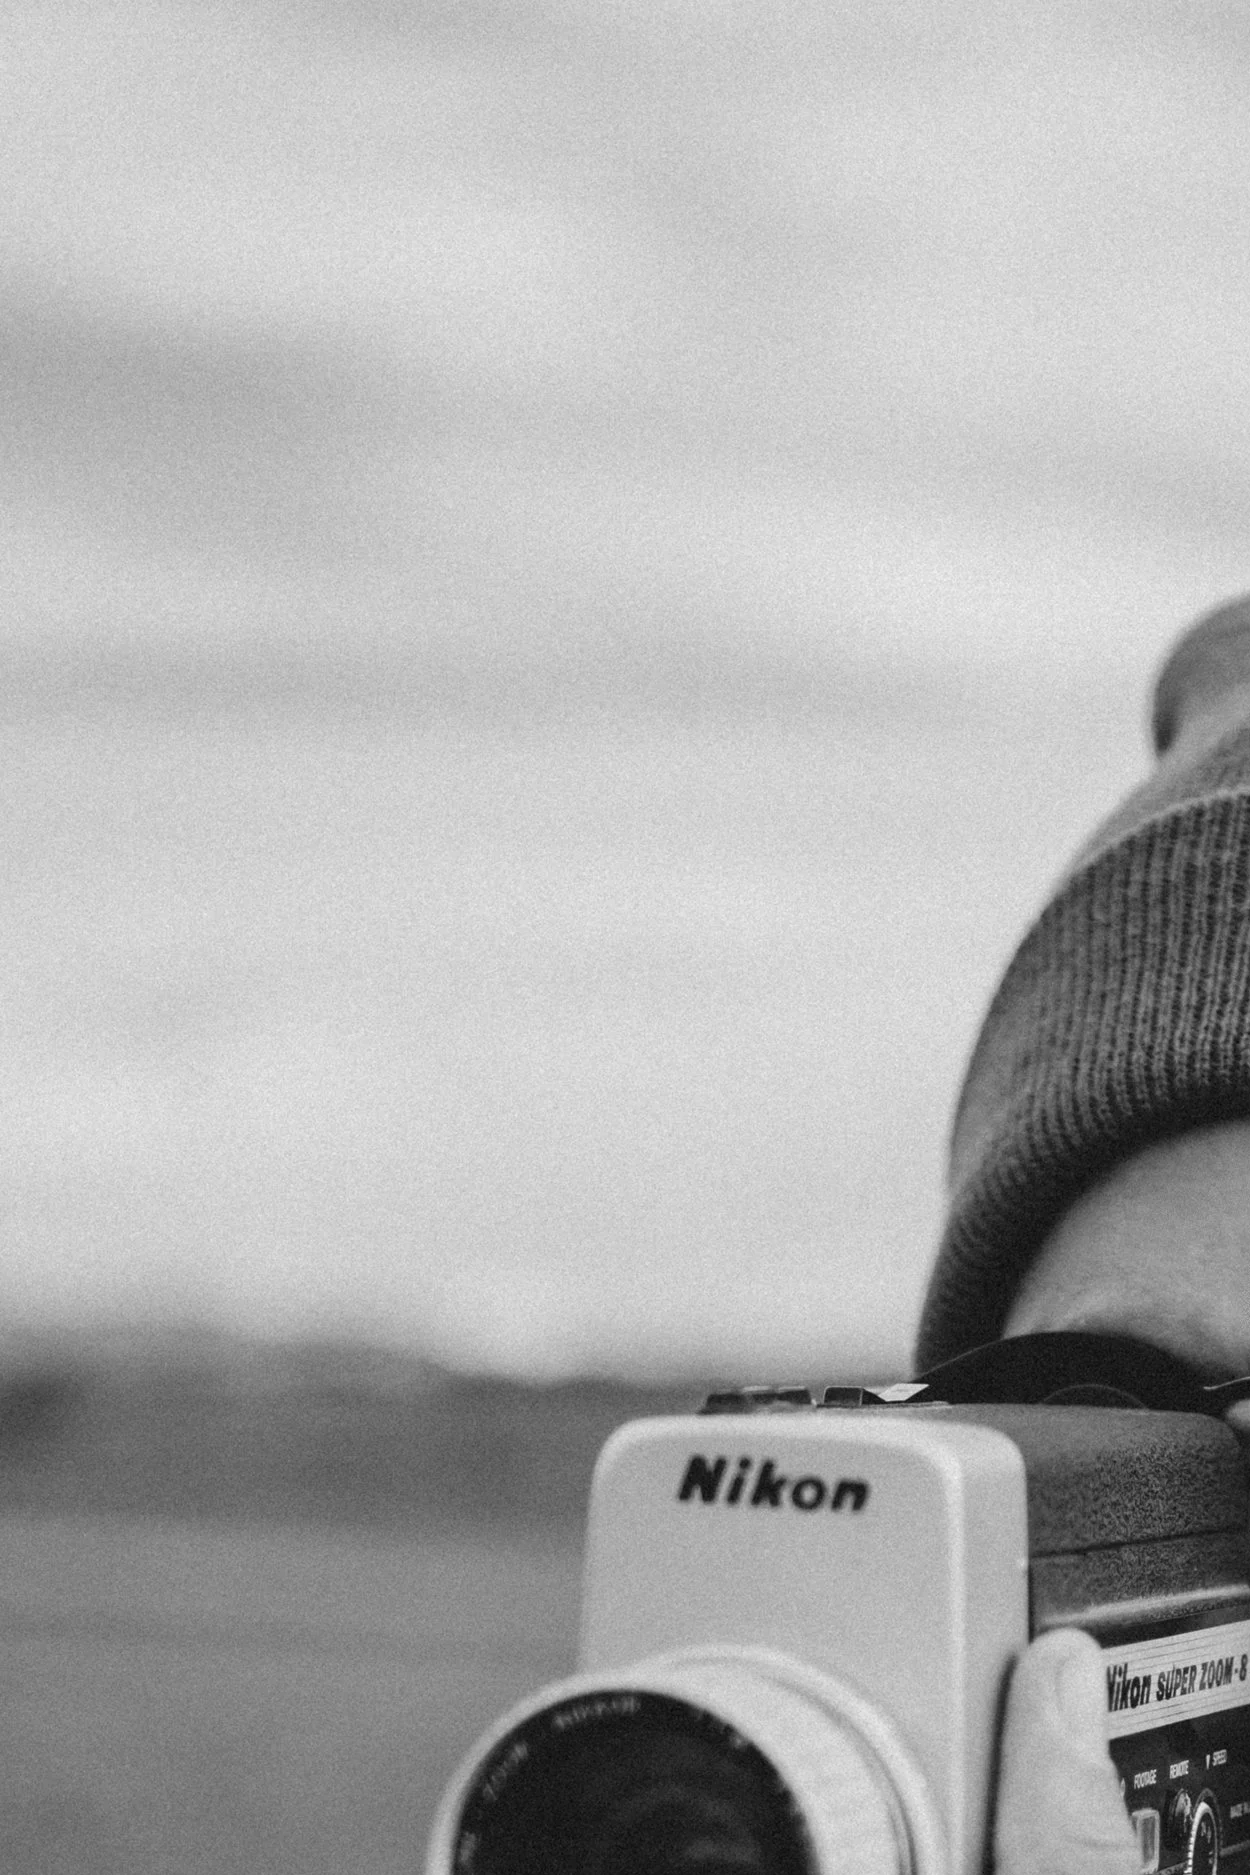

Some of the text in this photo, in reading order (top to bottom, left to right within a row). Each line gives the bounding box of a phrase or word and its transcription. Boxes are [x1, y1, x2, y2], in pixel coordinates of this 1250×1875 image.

[678, 1453, 871, 1513] Nikon
[1155, 1666, 1198, 1702] SUPER
[1133, 1768, 1158, 1789] FOOTAGE
[1169, 1759, 1190, 1780] REMOTE
